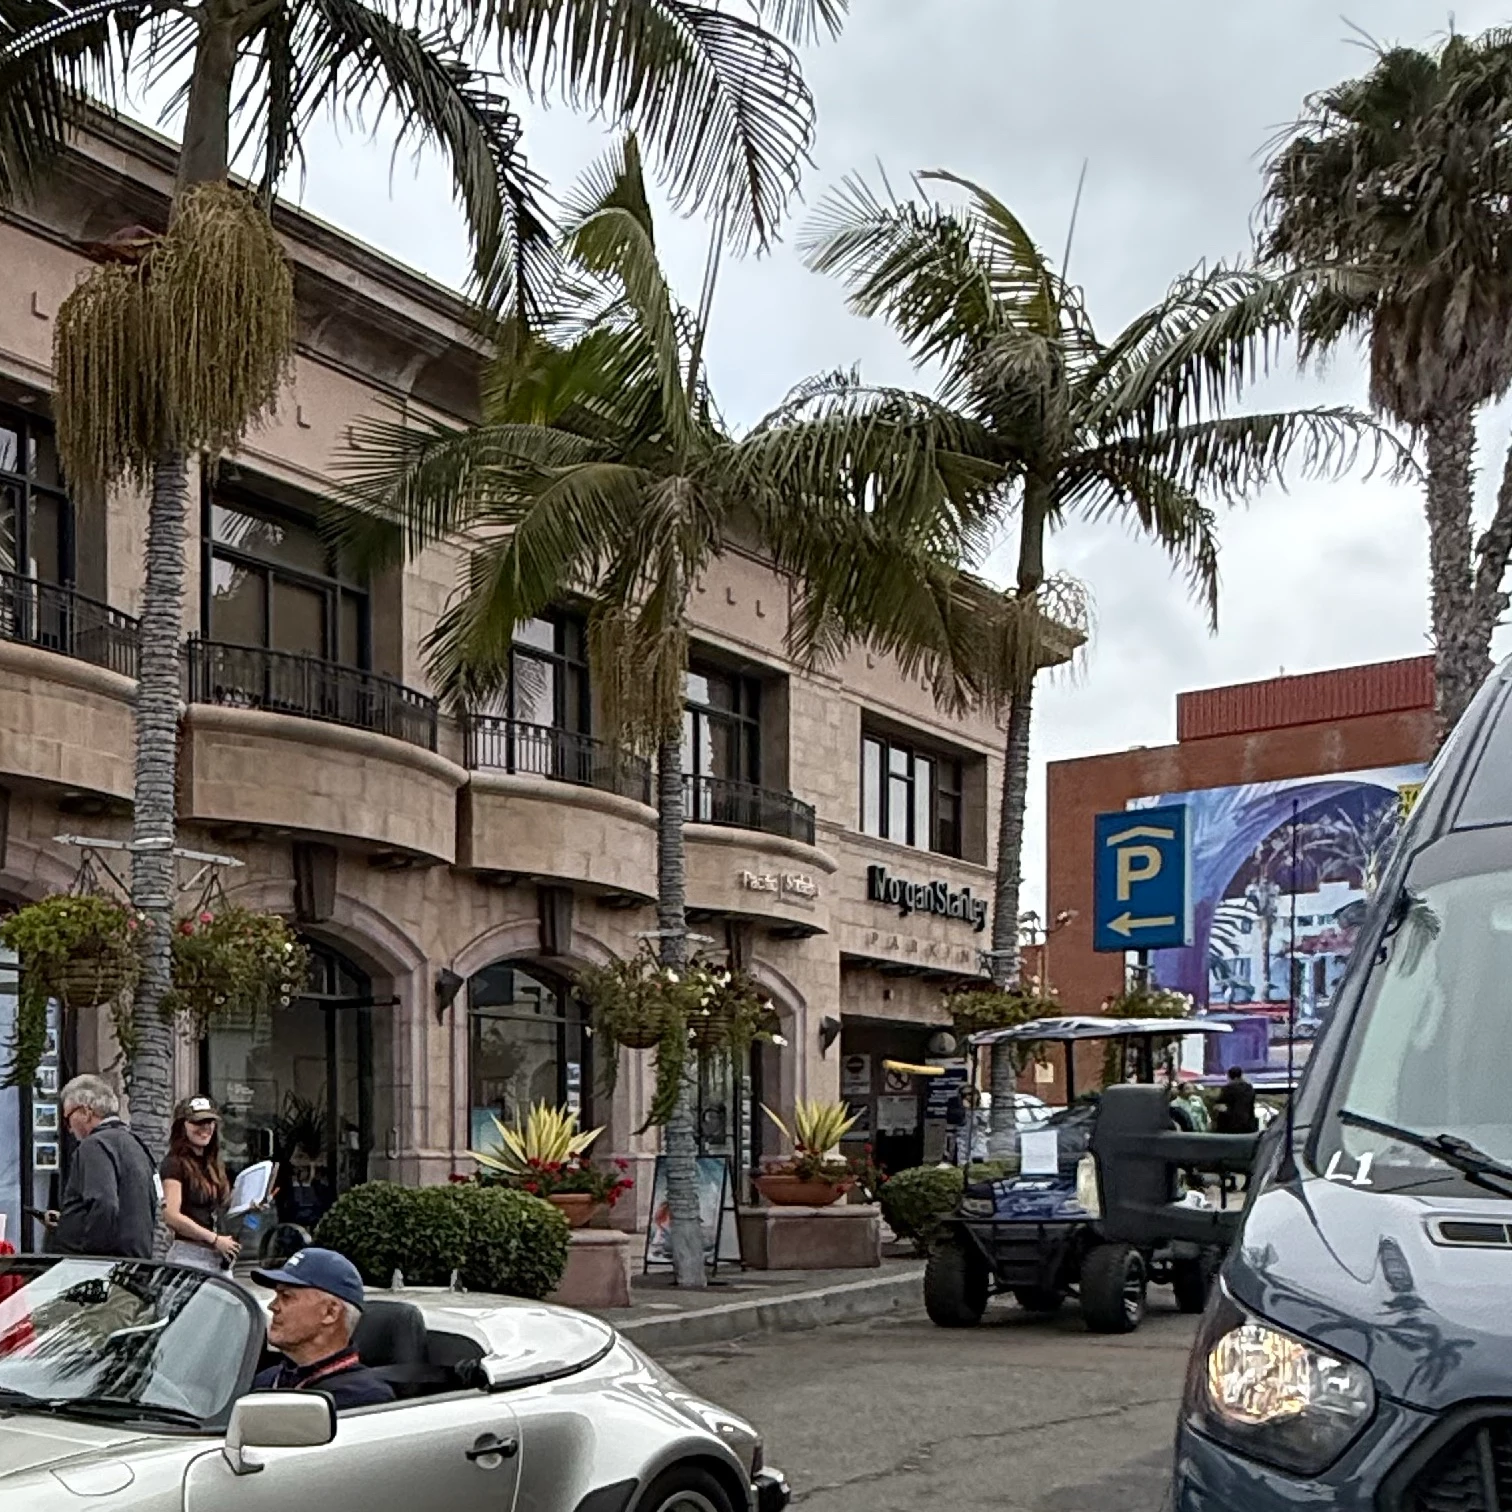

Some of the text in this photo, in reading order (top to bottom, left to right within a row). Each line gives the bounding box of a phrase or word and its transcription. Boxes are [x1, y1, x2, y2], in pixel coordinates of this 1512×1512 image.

[867, 866, 987, 932] Morgan Stanley
[1117, 845, 1162, 901] P
